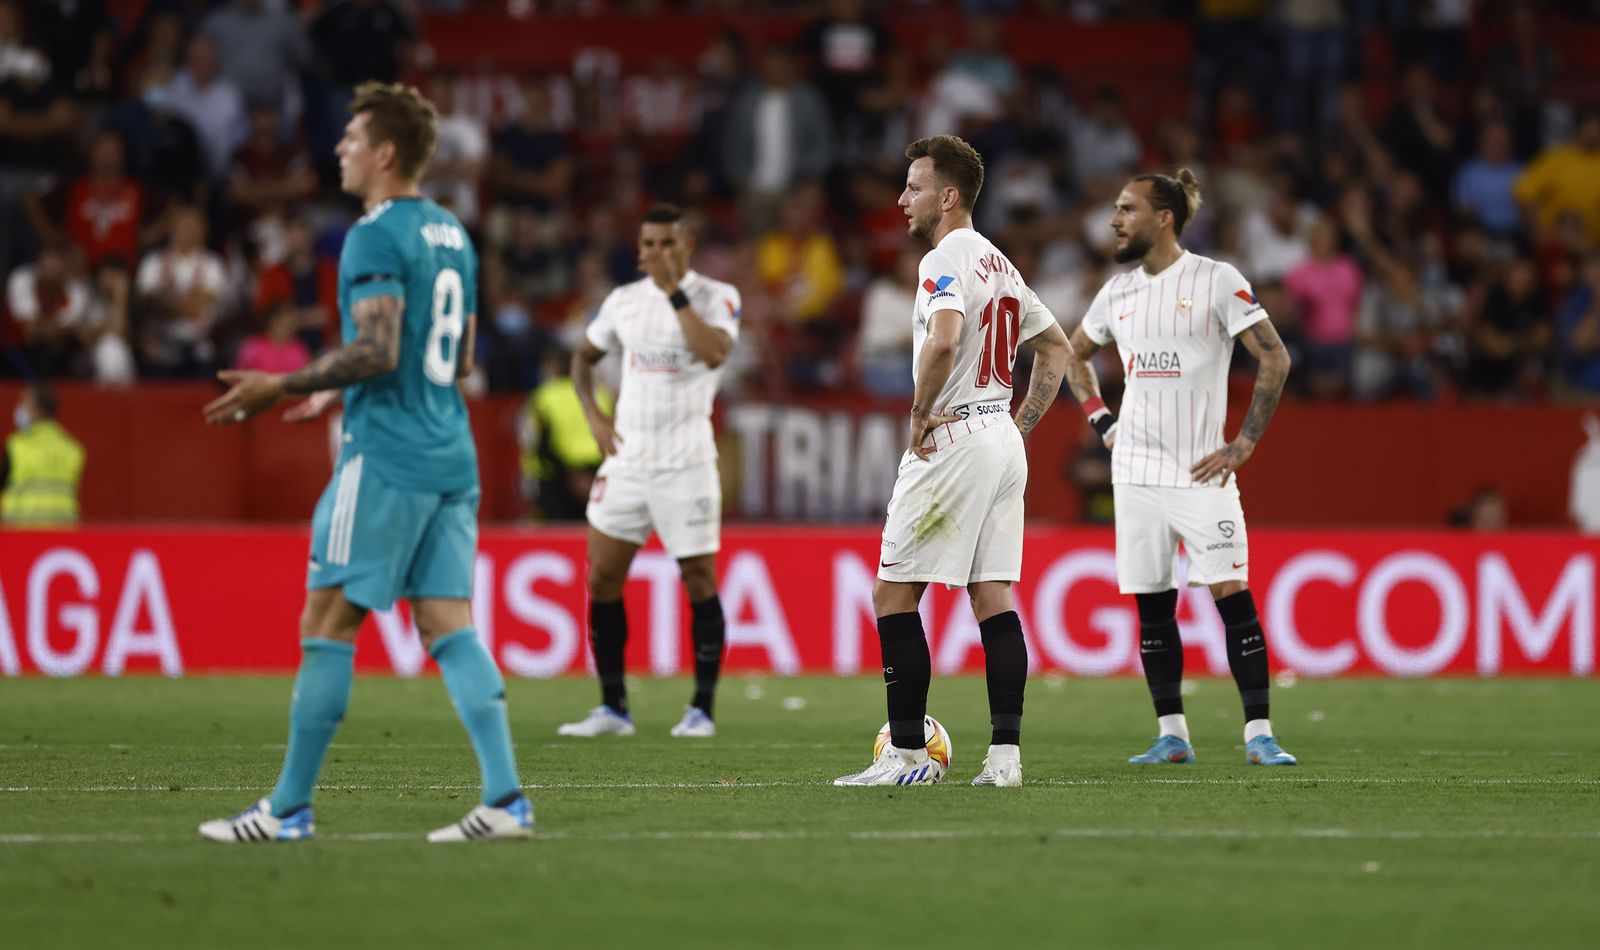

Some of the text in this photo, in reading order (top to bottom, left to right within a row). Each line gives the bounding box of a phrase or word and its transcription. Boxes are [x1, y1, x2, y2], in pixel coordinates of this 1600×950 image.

[423, 268, 464, 387] 8
[974, 296, 1021, 388] 10
[1136, 351, 1181, 370] NAGA
[726, 403, 910, 517] TRIA
